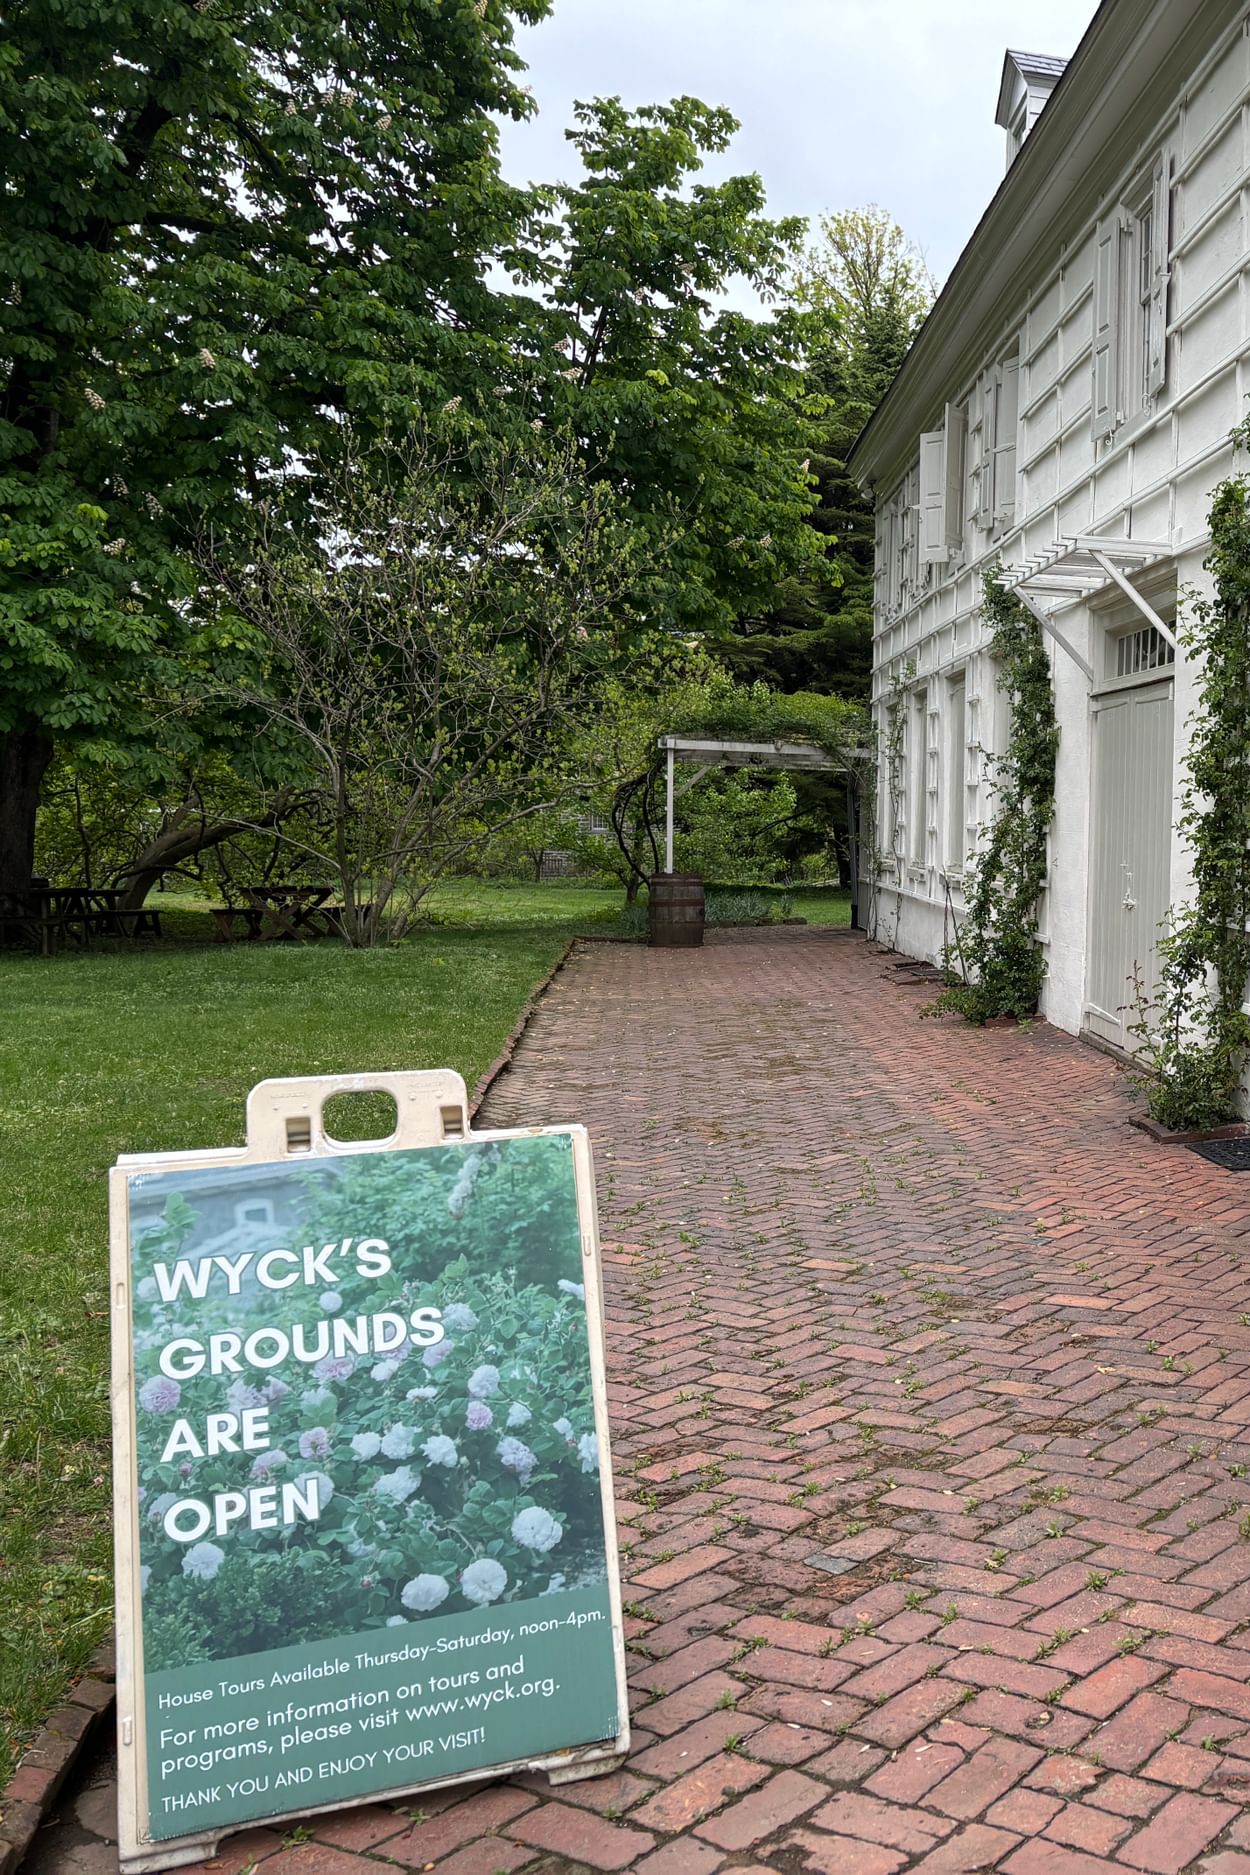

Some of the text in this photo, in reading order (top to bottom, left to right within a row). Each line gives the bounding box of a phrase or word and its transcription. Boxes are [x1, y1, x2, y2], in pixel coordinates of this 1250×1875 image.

[154, 1238, 392, 1302] WYCK'S
[159, 1307, 445, 1379] GROUNDS
[160, 1407, 270, 1463] ARE
[163, 1478, 320, 1542] OPEN
[158, 1610, 606, 1709] House Tours Available Thursday-Saturday, noon-4pm.
[160, 1654, 525, 1749] For more information on tours and
[161, 1677, 561, 1780] programs, please visit www.wyck.org.
[161, 1726, 486, 1813] THANK YOU AND ENJOY YOUR VISIT!
